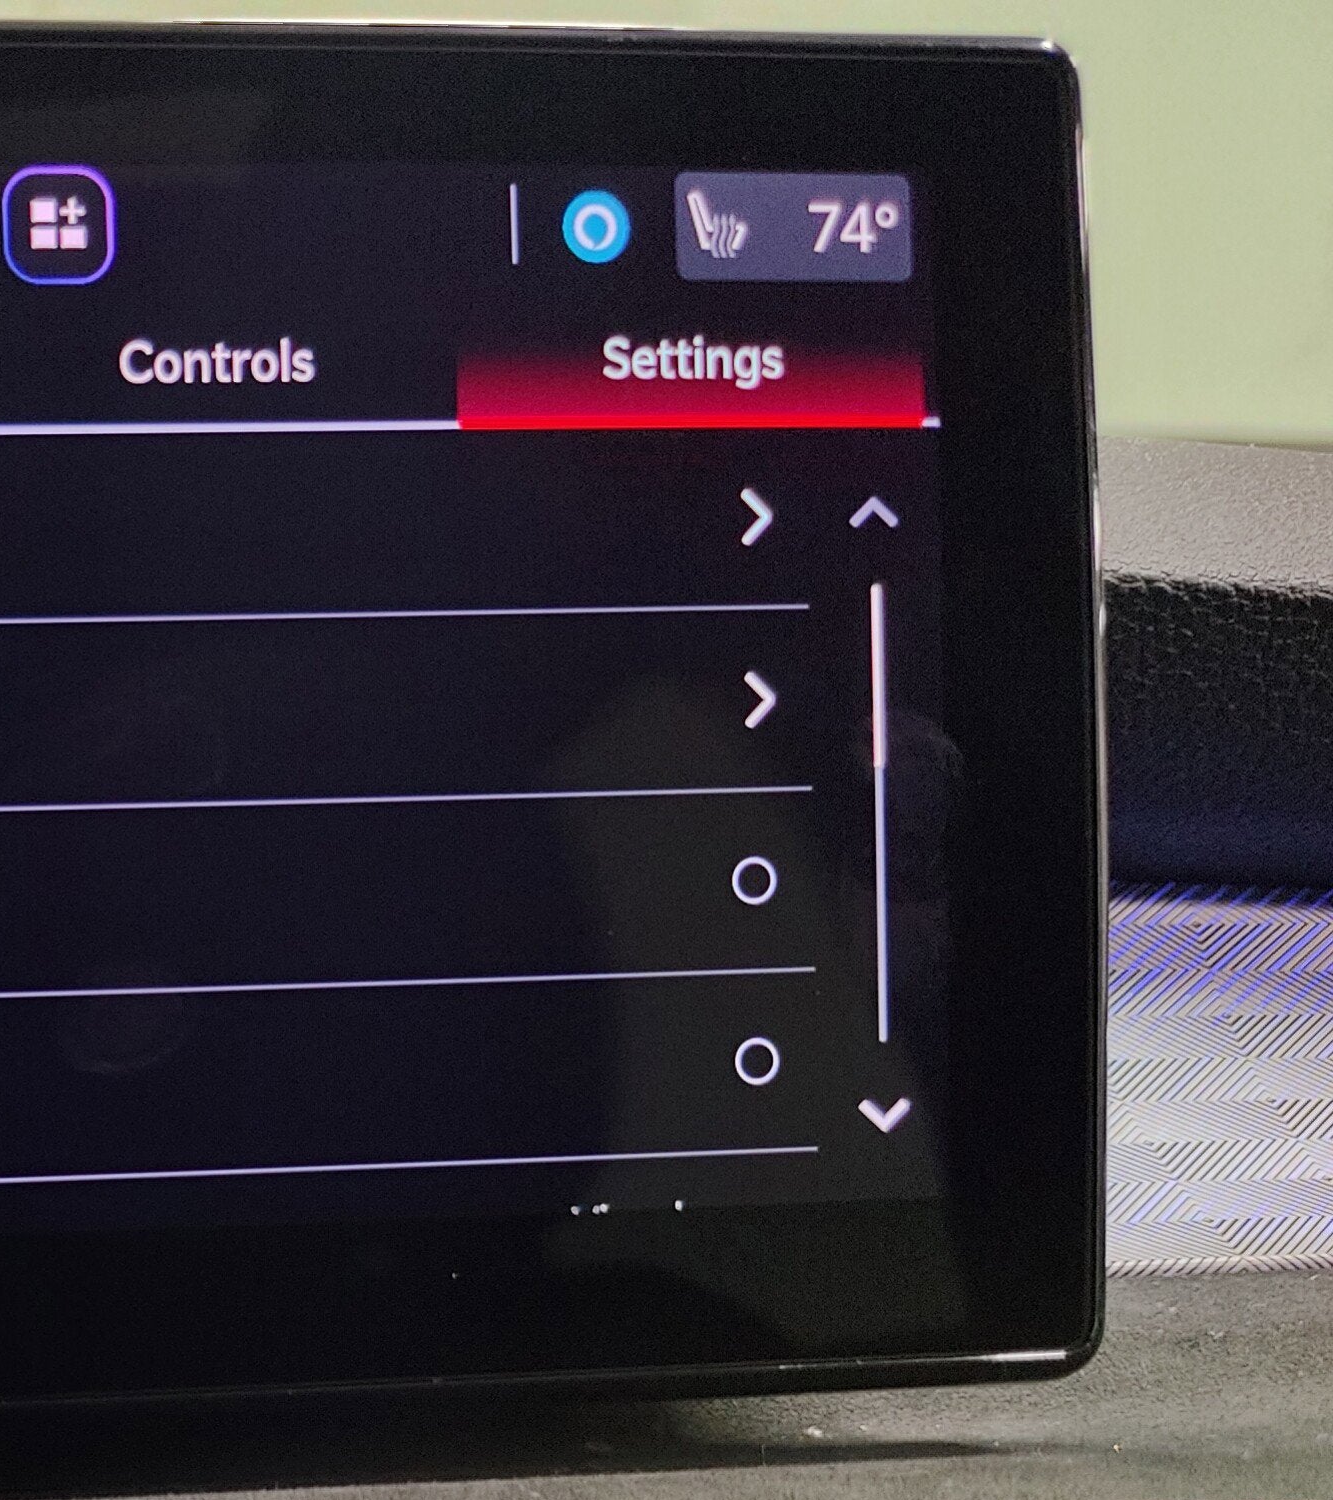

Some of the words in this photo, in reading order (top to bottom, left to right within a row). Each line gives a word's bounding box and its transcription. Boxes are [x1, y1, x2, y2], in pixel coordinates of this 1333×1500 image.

[807, 200, 898, 254] 74°
[119, 337, 316, 384] Controls
[602, 335, 785, 388] Settings
